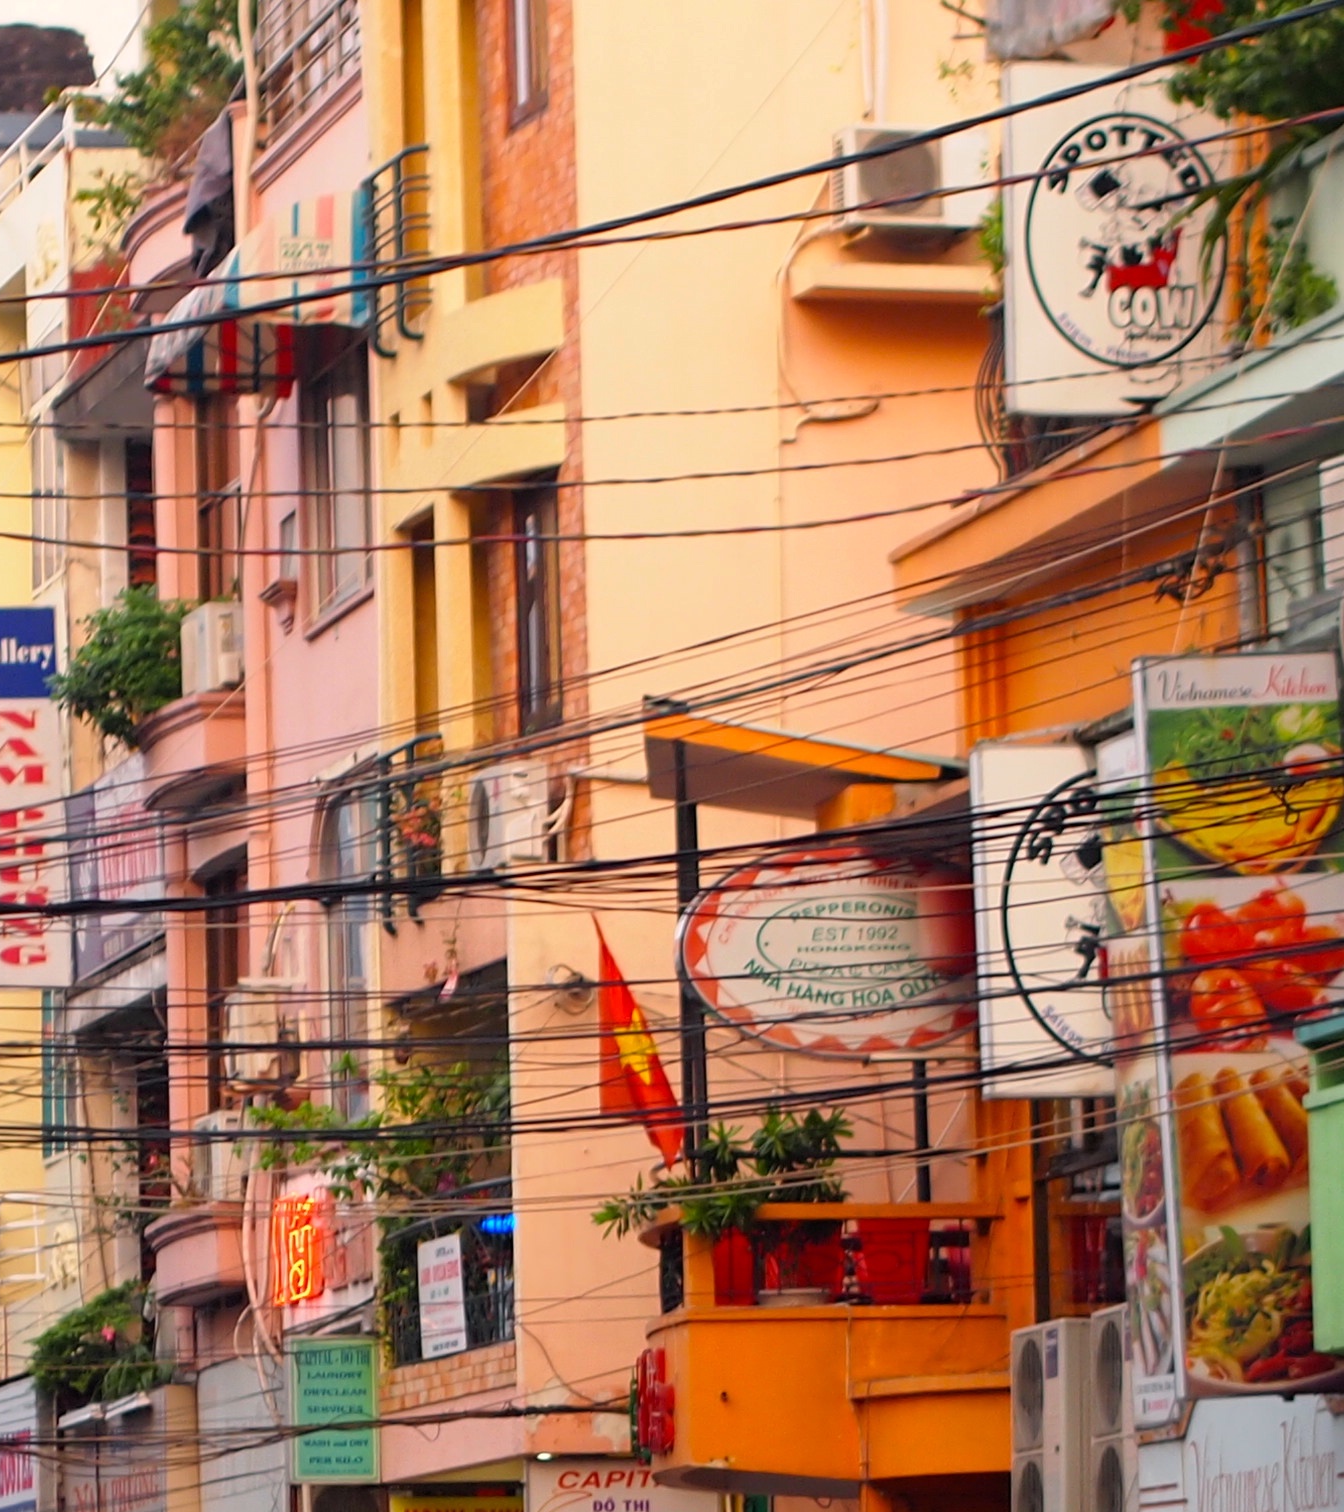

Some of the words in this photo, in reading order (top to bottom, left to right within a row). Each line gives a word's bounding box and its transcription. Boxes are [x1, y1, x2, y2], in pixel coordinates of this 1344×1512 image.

[1254, 663, 1328, 699] Kitchen
[811, 926, 850, 943] EST
[856, 925, 899, 941] 1992
[797, 944, 910, 953] HONGKONG
[852, 986, 895, 1008] HOA
[307, 1371, 363, 1380] LAUNDRY
[303, 1388, 367, 1396] DRYCLEAN
[558, 1470, 660, 1490] CAPIT
